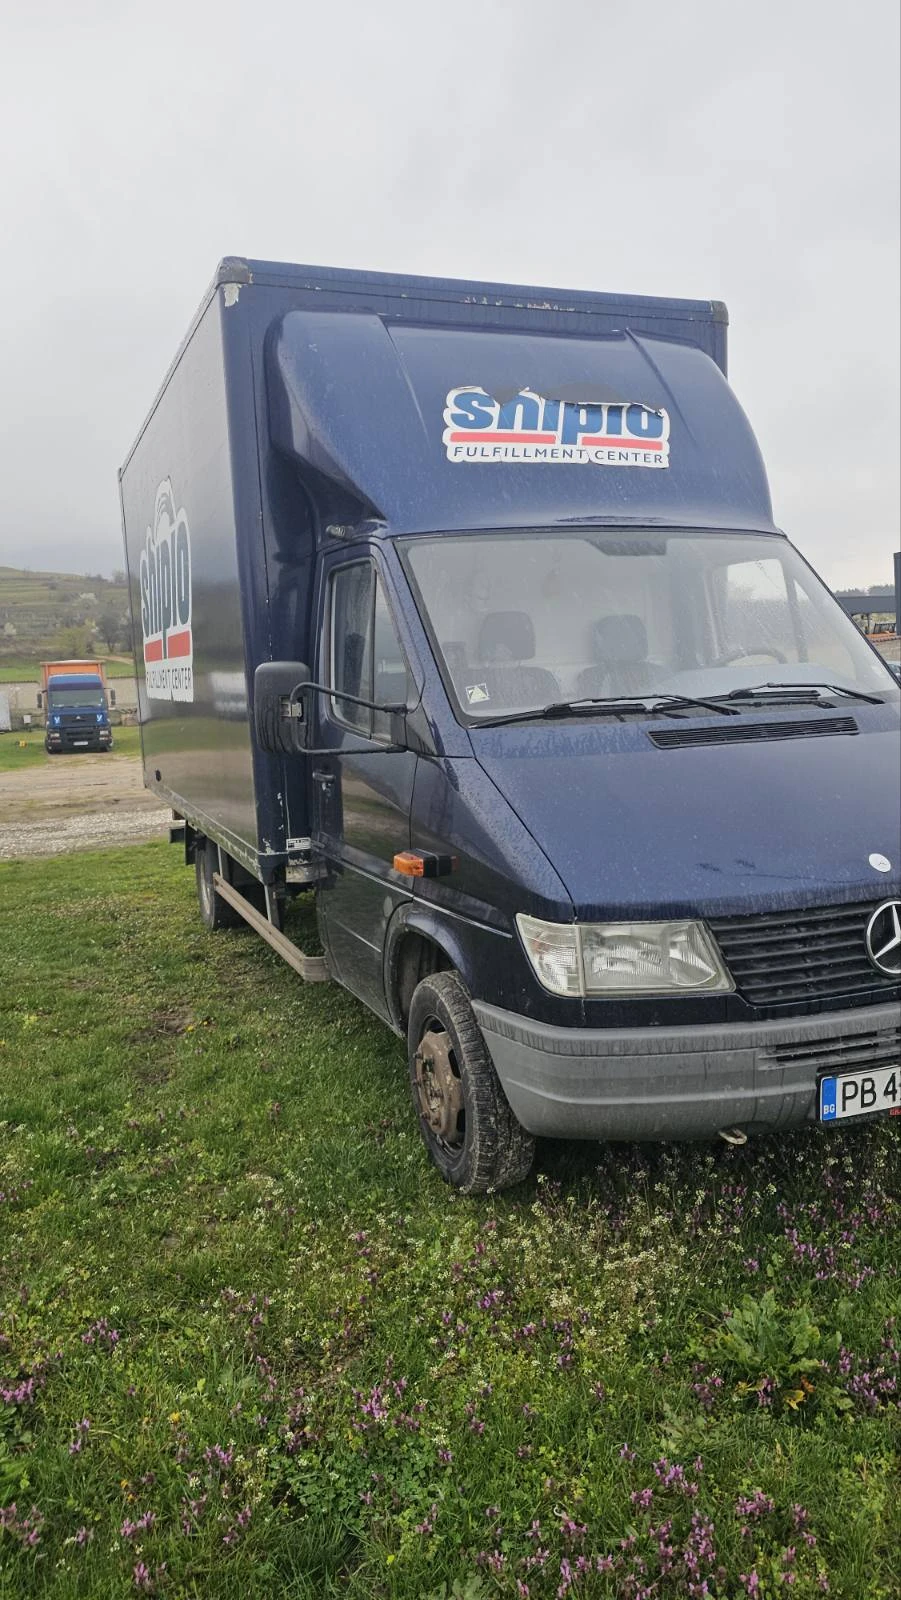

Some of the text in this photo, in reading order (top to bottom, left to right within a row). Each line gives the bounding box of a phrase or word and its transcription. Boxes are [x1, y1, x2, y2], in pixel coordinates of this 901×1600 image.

[453, 446, 664, 465] FULFILLMENT CENTER
[171, 667, 192, 690] CENTER
[841, 1072, 901, 1112] PB 4
[823, 1104, 836, 1115] BG
